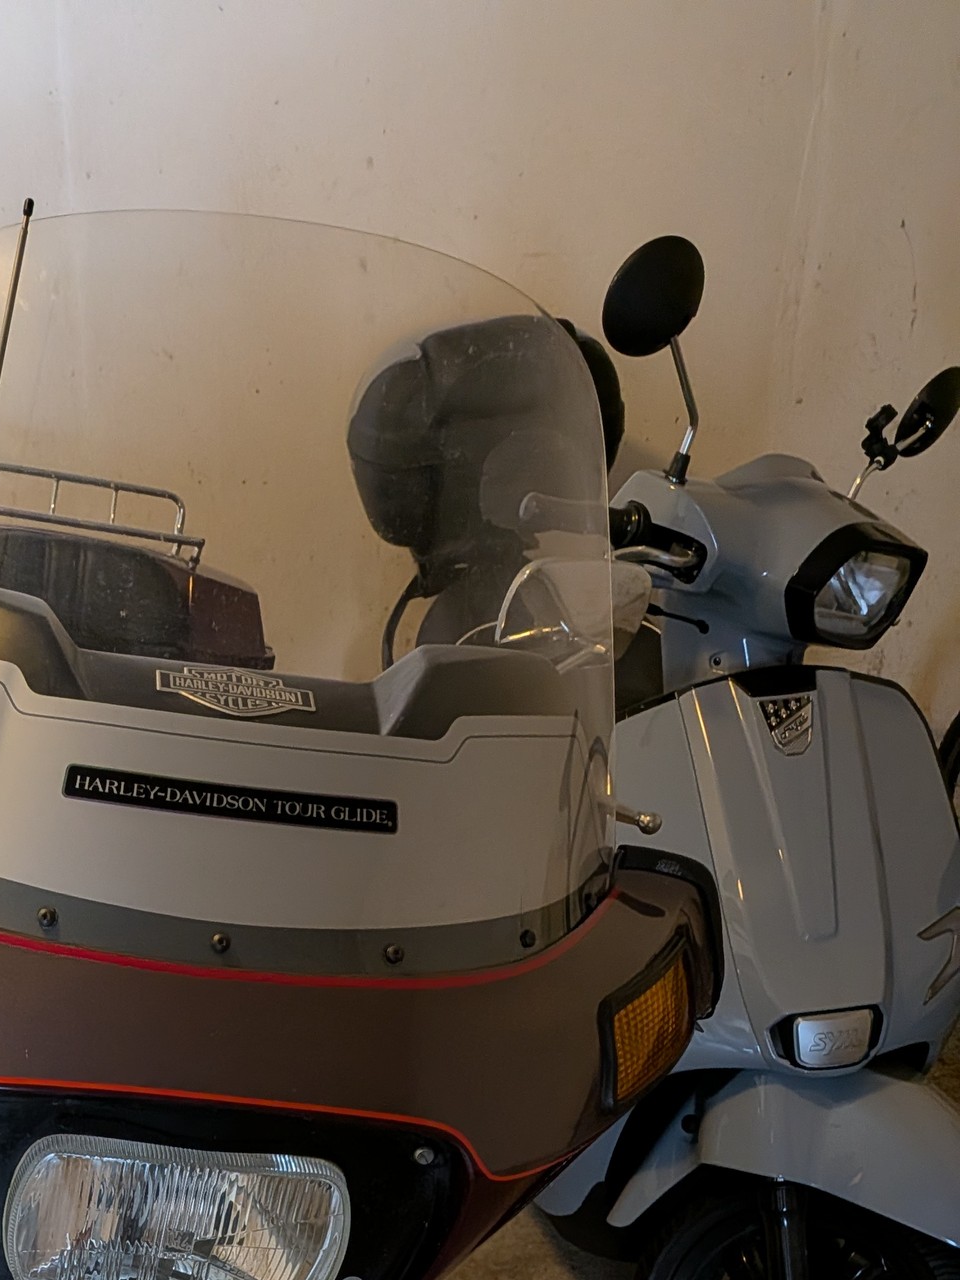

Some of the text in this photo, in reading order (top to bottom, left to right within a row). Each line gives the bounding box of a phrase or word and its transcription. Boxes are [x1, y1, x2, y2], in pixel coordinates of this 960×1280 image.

[175, 677, 296, 703] HARLEY-DAVIDSON
[203, 672, 264, 687] MOTOR
[205, 693, 269, 711] CYCLES
[74, 775, 268, 813] HARLEY-DAVIDSON
[272, 799, 326, 819] TOUR
